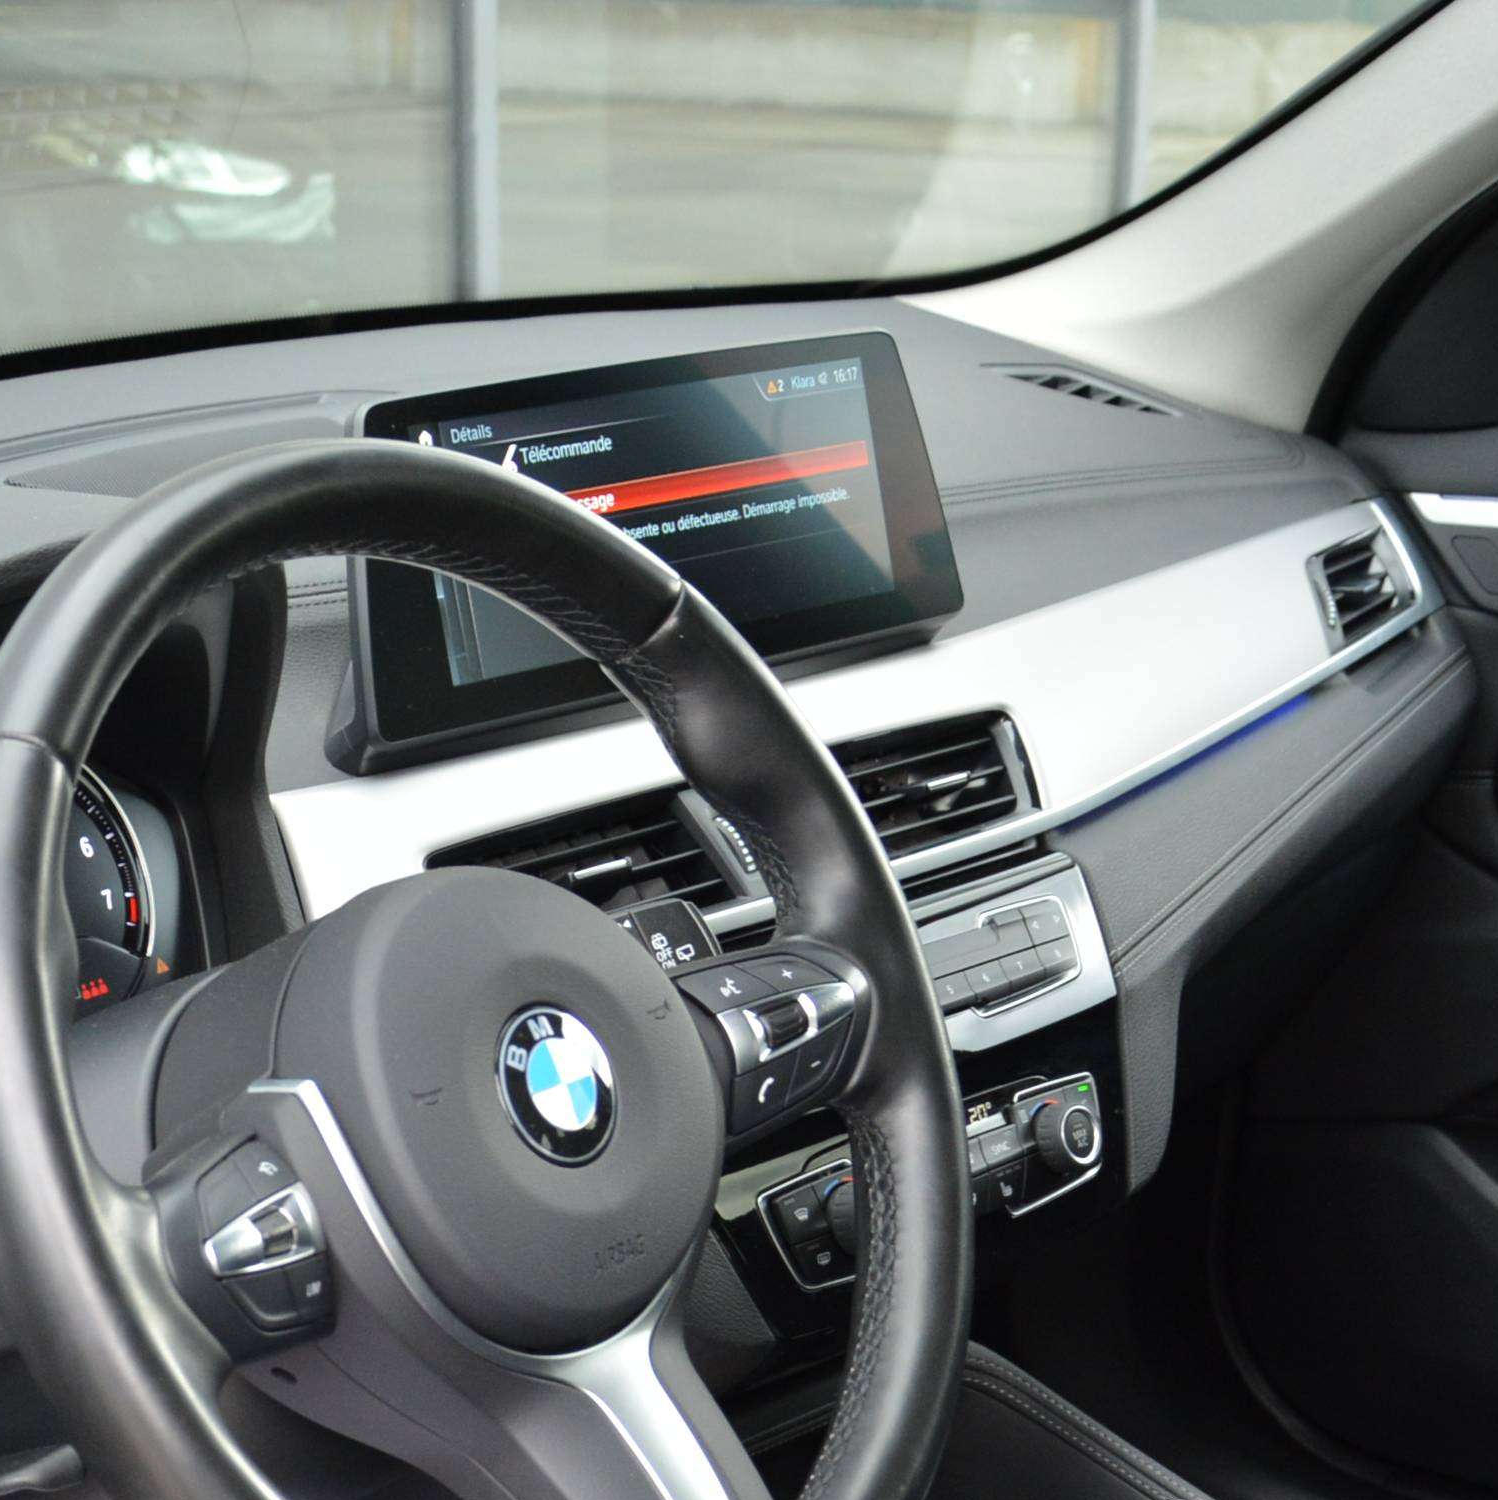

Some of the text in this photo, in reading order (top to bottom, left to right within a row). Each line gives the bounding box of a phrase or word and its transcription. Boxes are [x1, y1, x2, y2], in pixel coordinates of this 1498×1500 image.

[833, 366, 858, 384] 16:17
[451, 424, 493, 444] Détails
[519, 434, 613, 465] Télécommande
[577, 492, 615, 513] ssage
[622, 486, 851, 542] bsente ou défectueuse. Démarrage impossible.
[79, 836, 94, 859] 6
[101, 888, 113, 911] 7
